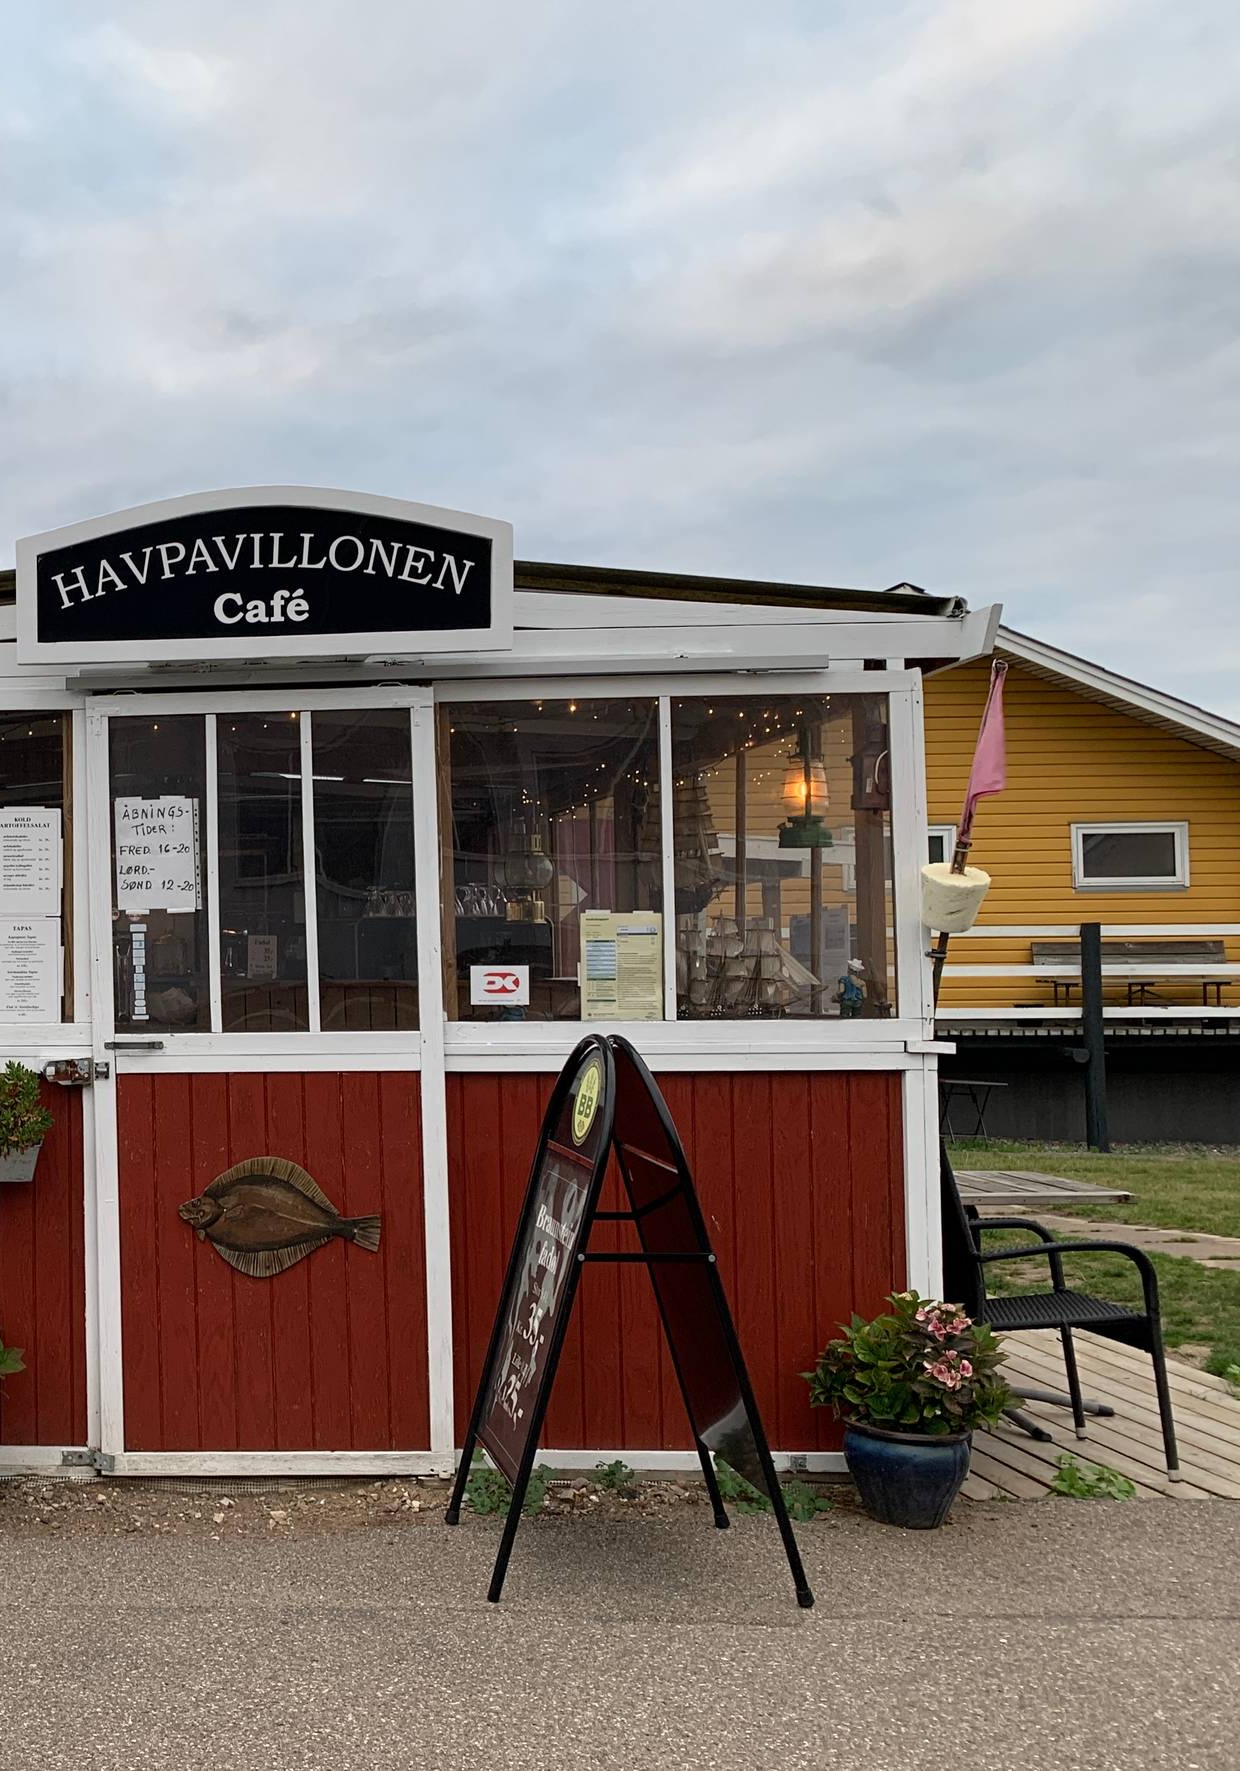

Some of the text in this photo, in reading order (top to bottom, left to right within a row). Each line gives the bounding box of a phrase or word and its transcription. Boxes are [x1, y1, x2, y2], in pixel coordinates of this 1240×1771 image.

[51, 532, 476, 610] HAVPAVILLONEN
[213, 588, 310, 625] Café
[577, 1093, 593, 1119] BB
